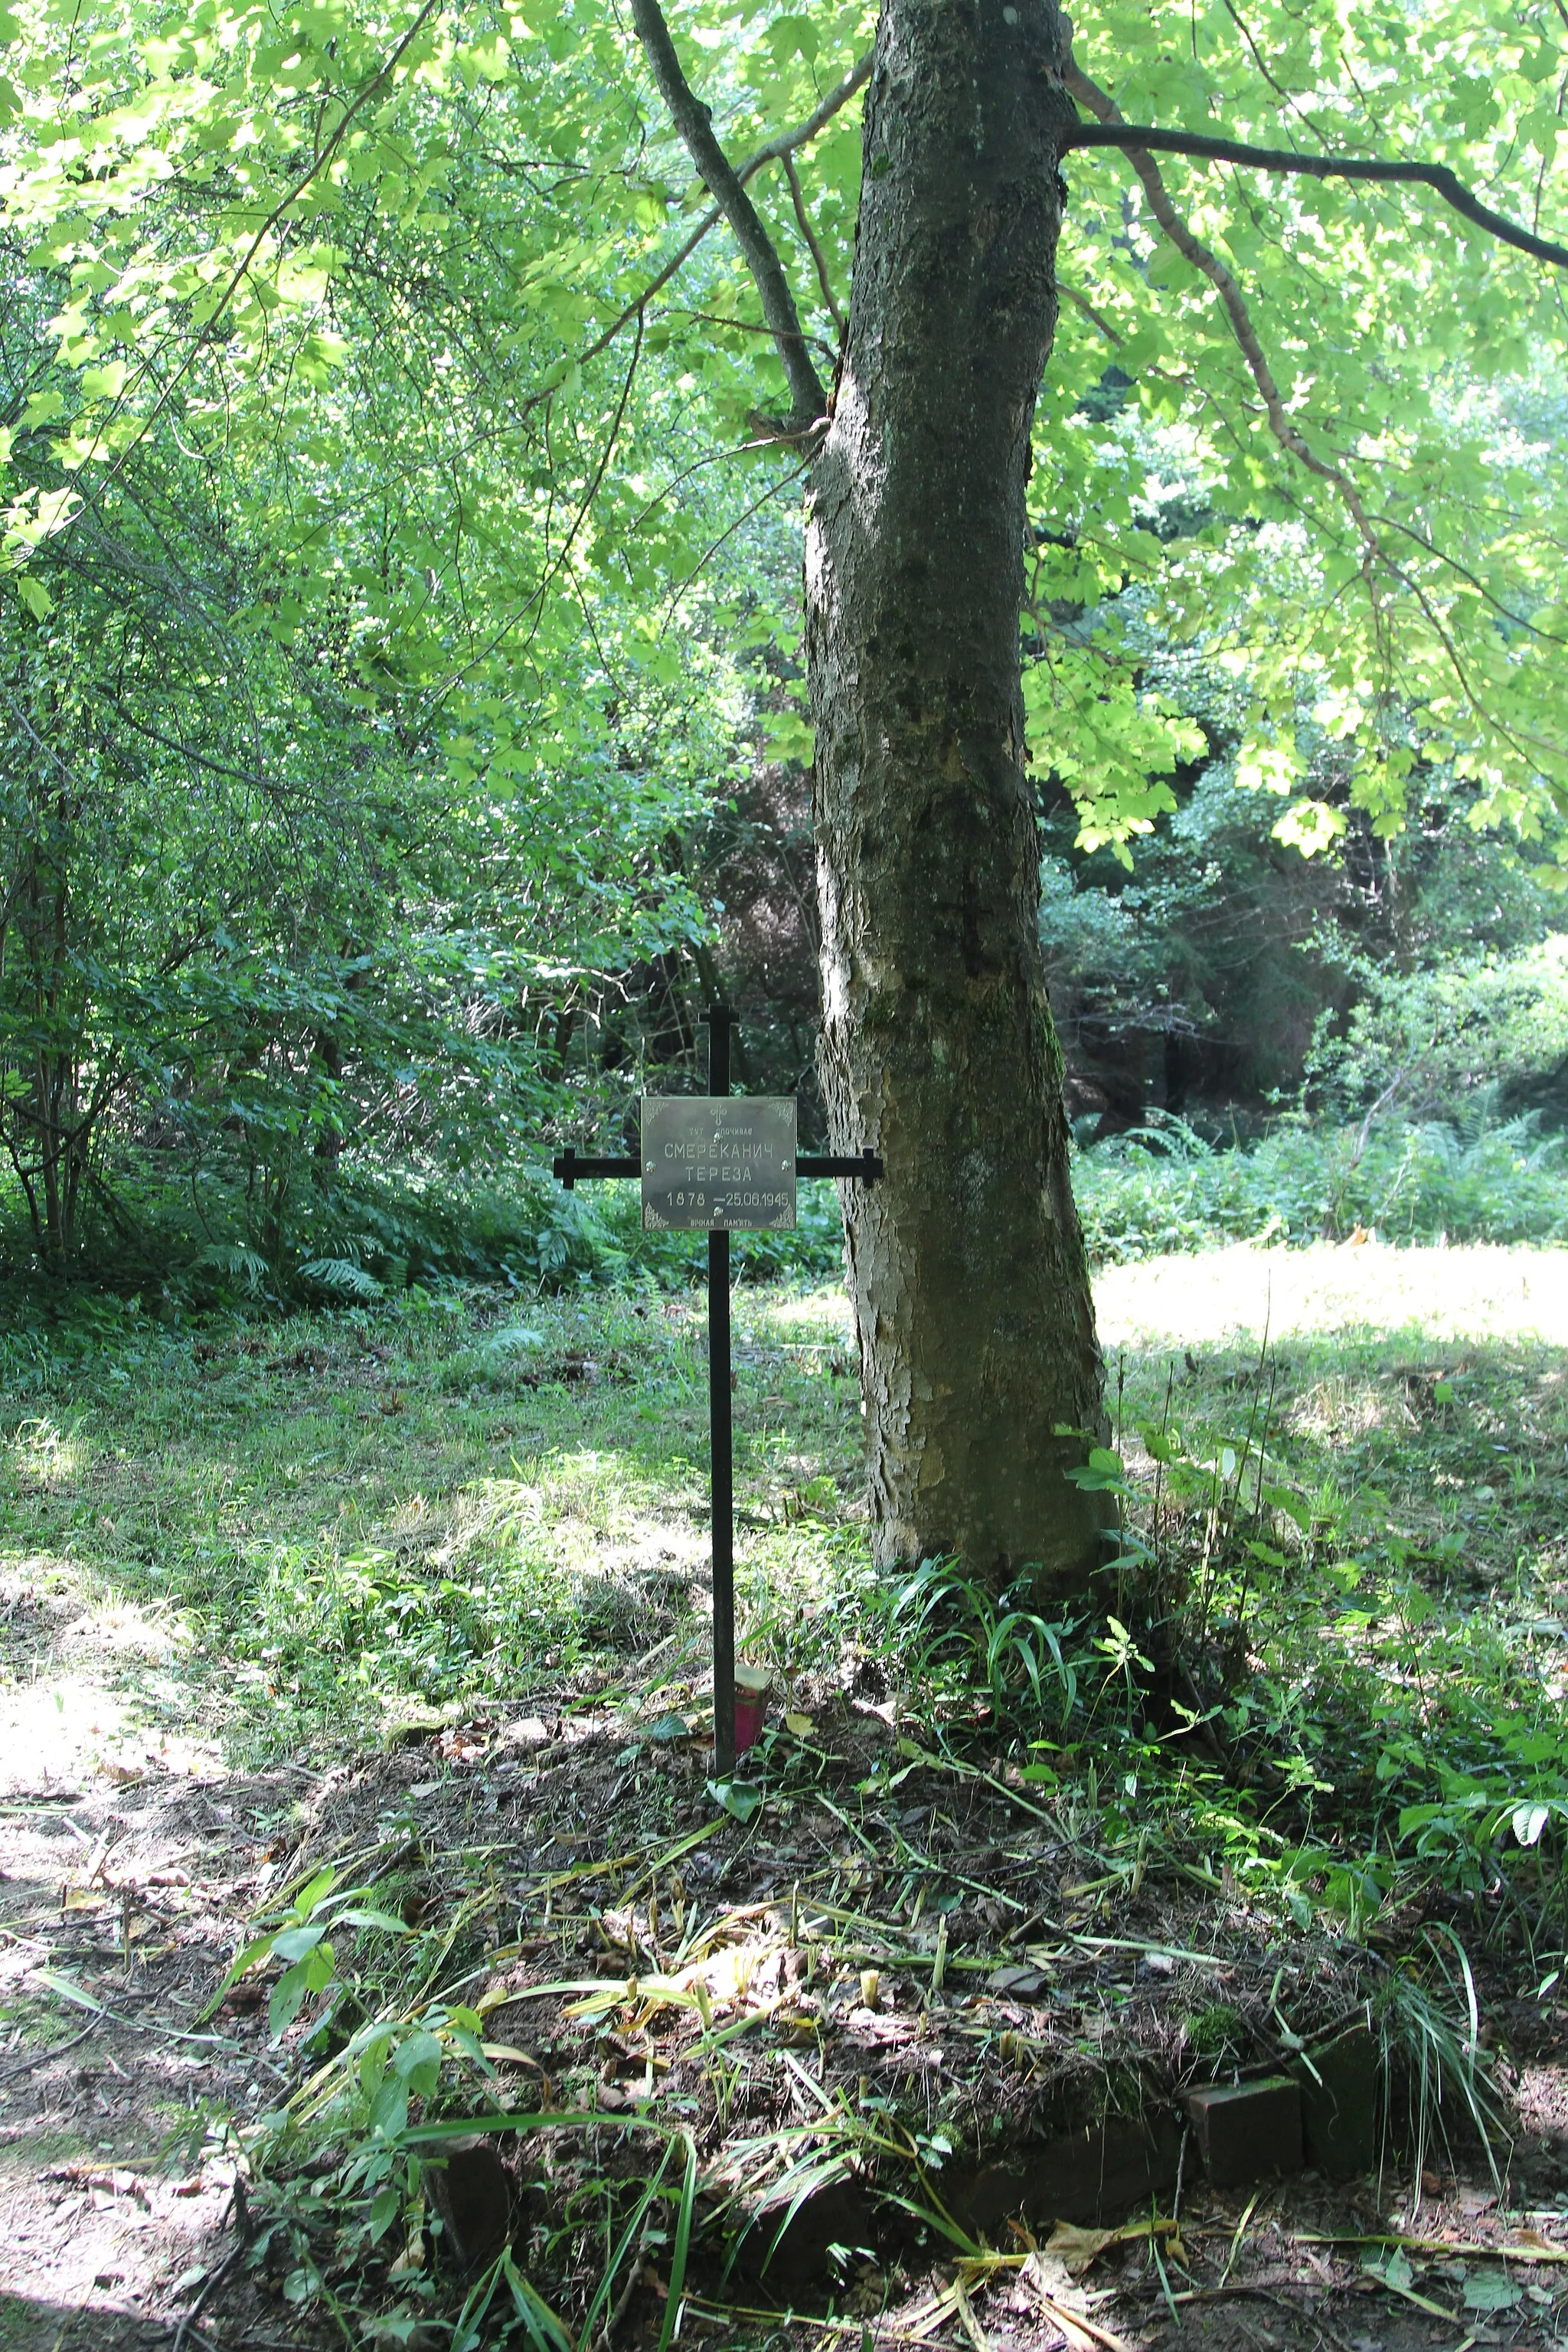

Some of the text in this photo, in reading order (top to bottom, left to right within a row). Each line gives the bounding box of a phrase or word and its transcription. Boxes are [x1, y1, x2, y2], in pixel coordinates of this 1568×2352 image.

[689, 1127, 704, 1135] ТУТ
[665, 1143, 773, 1158] СМЕРЕКАНИЧ
[685, 1166, 752, 1181] ТЕРЕЗА
[667, 1191, 705, 1207] 1878
